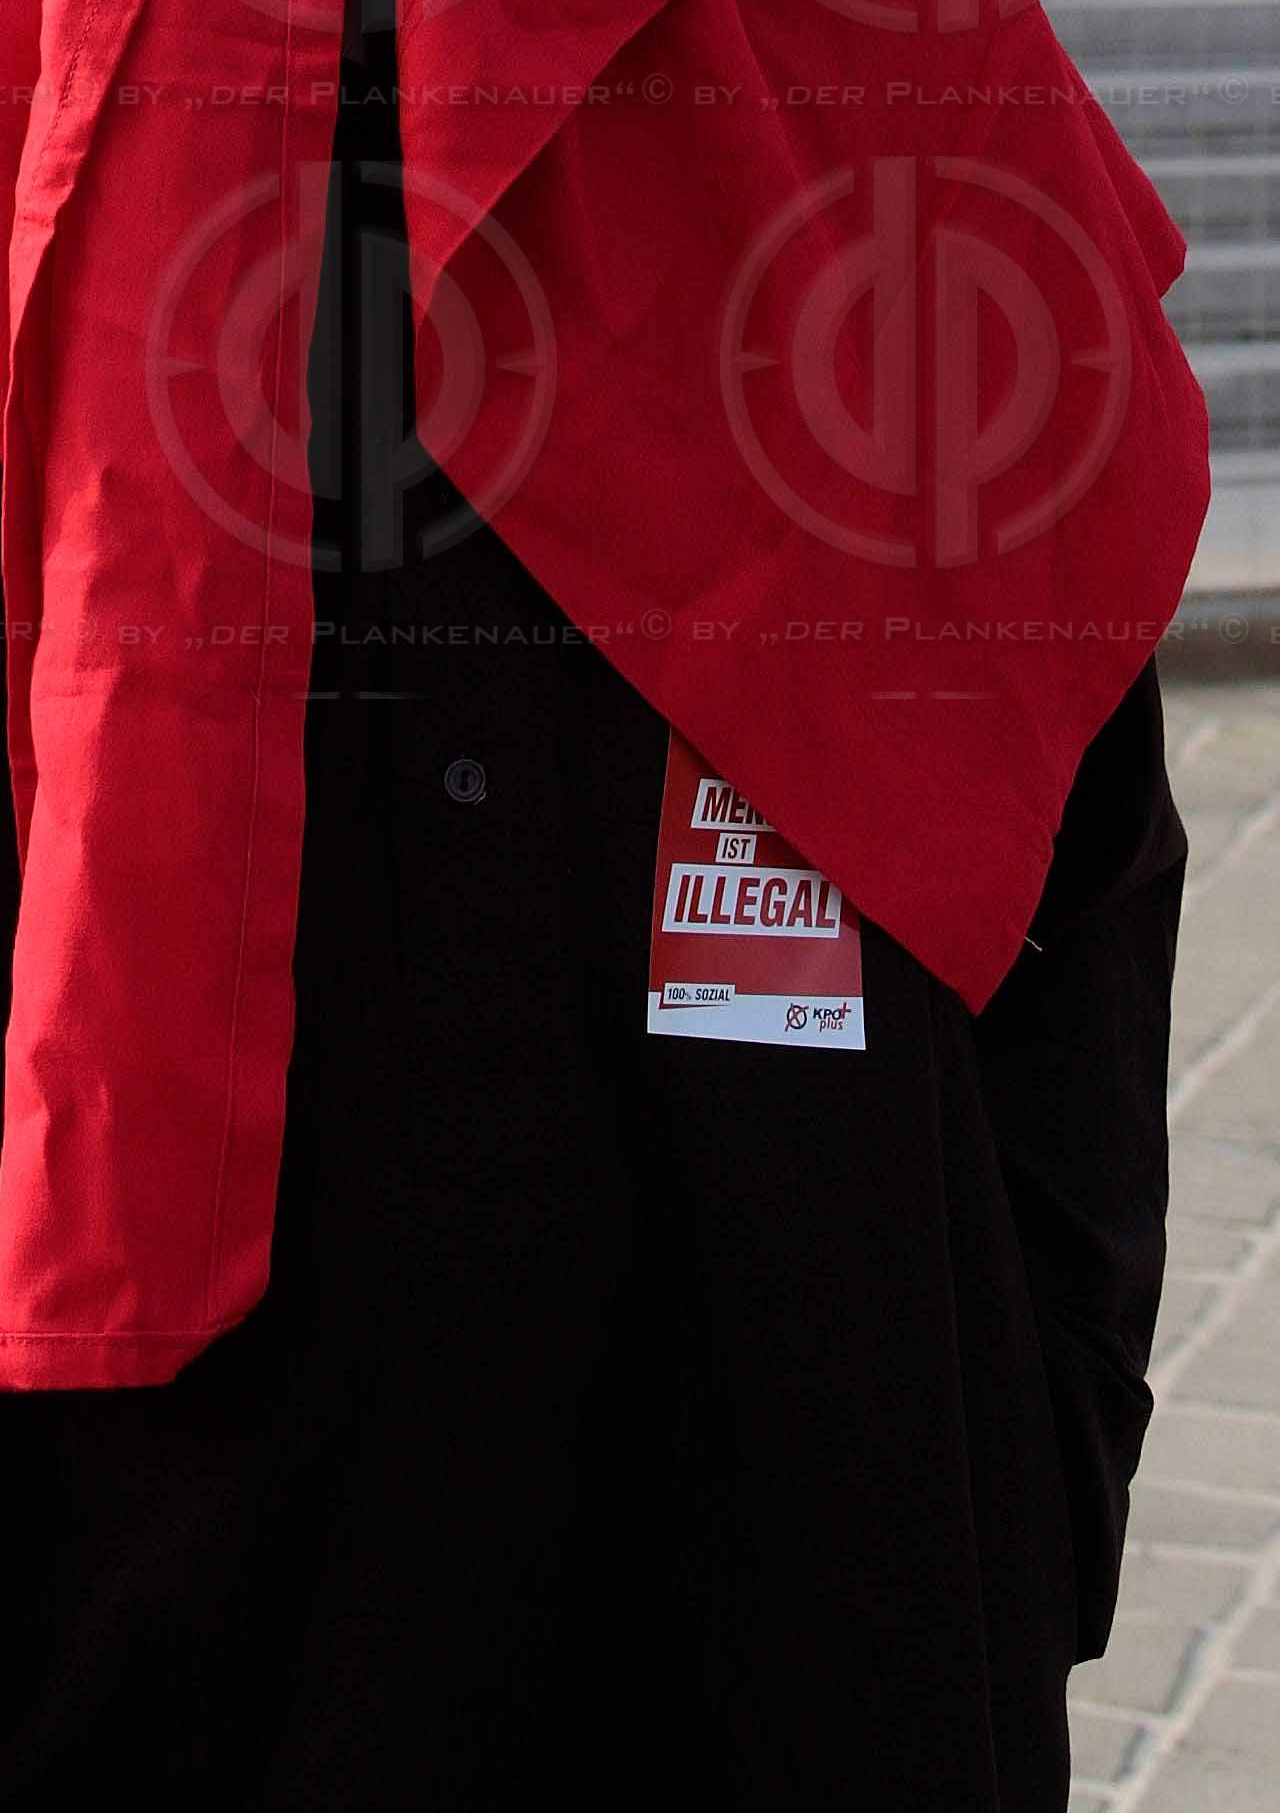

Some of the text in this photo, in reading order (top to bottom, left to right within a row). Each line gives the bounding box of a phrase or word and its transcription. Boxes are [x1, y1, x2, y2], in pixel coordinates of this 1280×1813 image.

[722, 837, 751, 860] IST
[674, 874, 838, 929] ILLEGAL
[695, 988, 731, 1002] SOZIAL
[819, 1016, 843, 1033] plus
